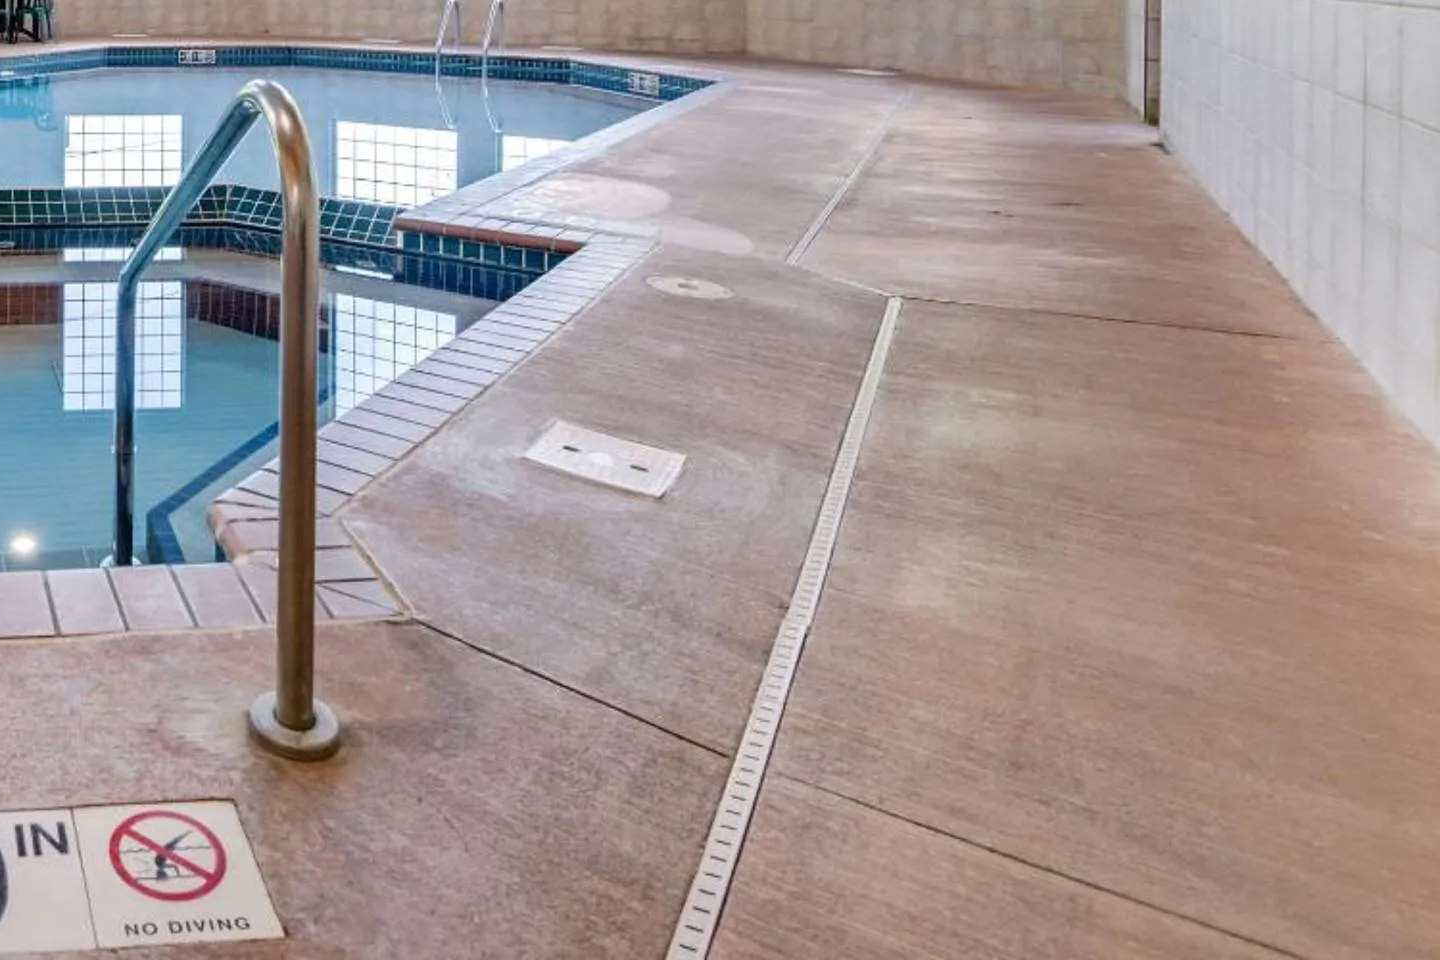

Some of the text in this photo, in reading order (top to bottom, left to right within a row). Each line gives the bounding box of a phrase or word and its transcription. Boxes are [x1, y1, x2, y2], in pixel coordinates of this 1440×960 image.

[14, 821, 69, 857] IN
[124, 917, 250, 936] NO DIVING
